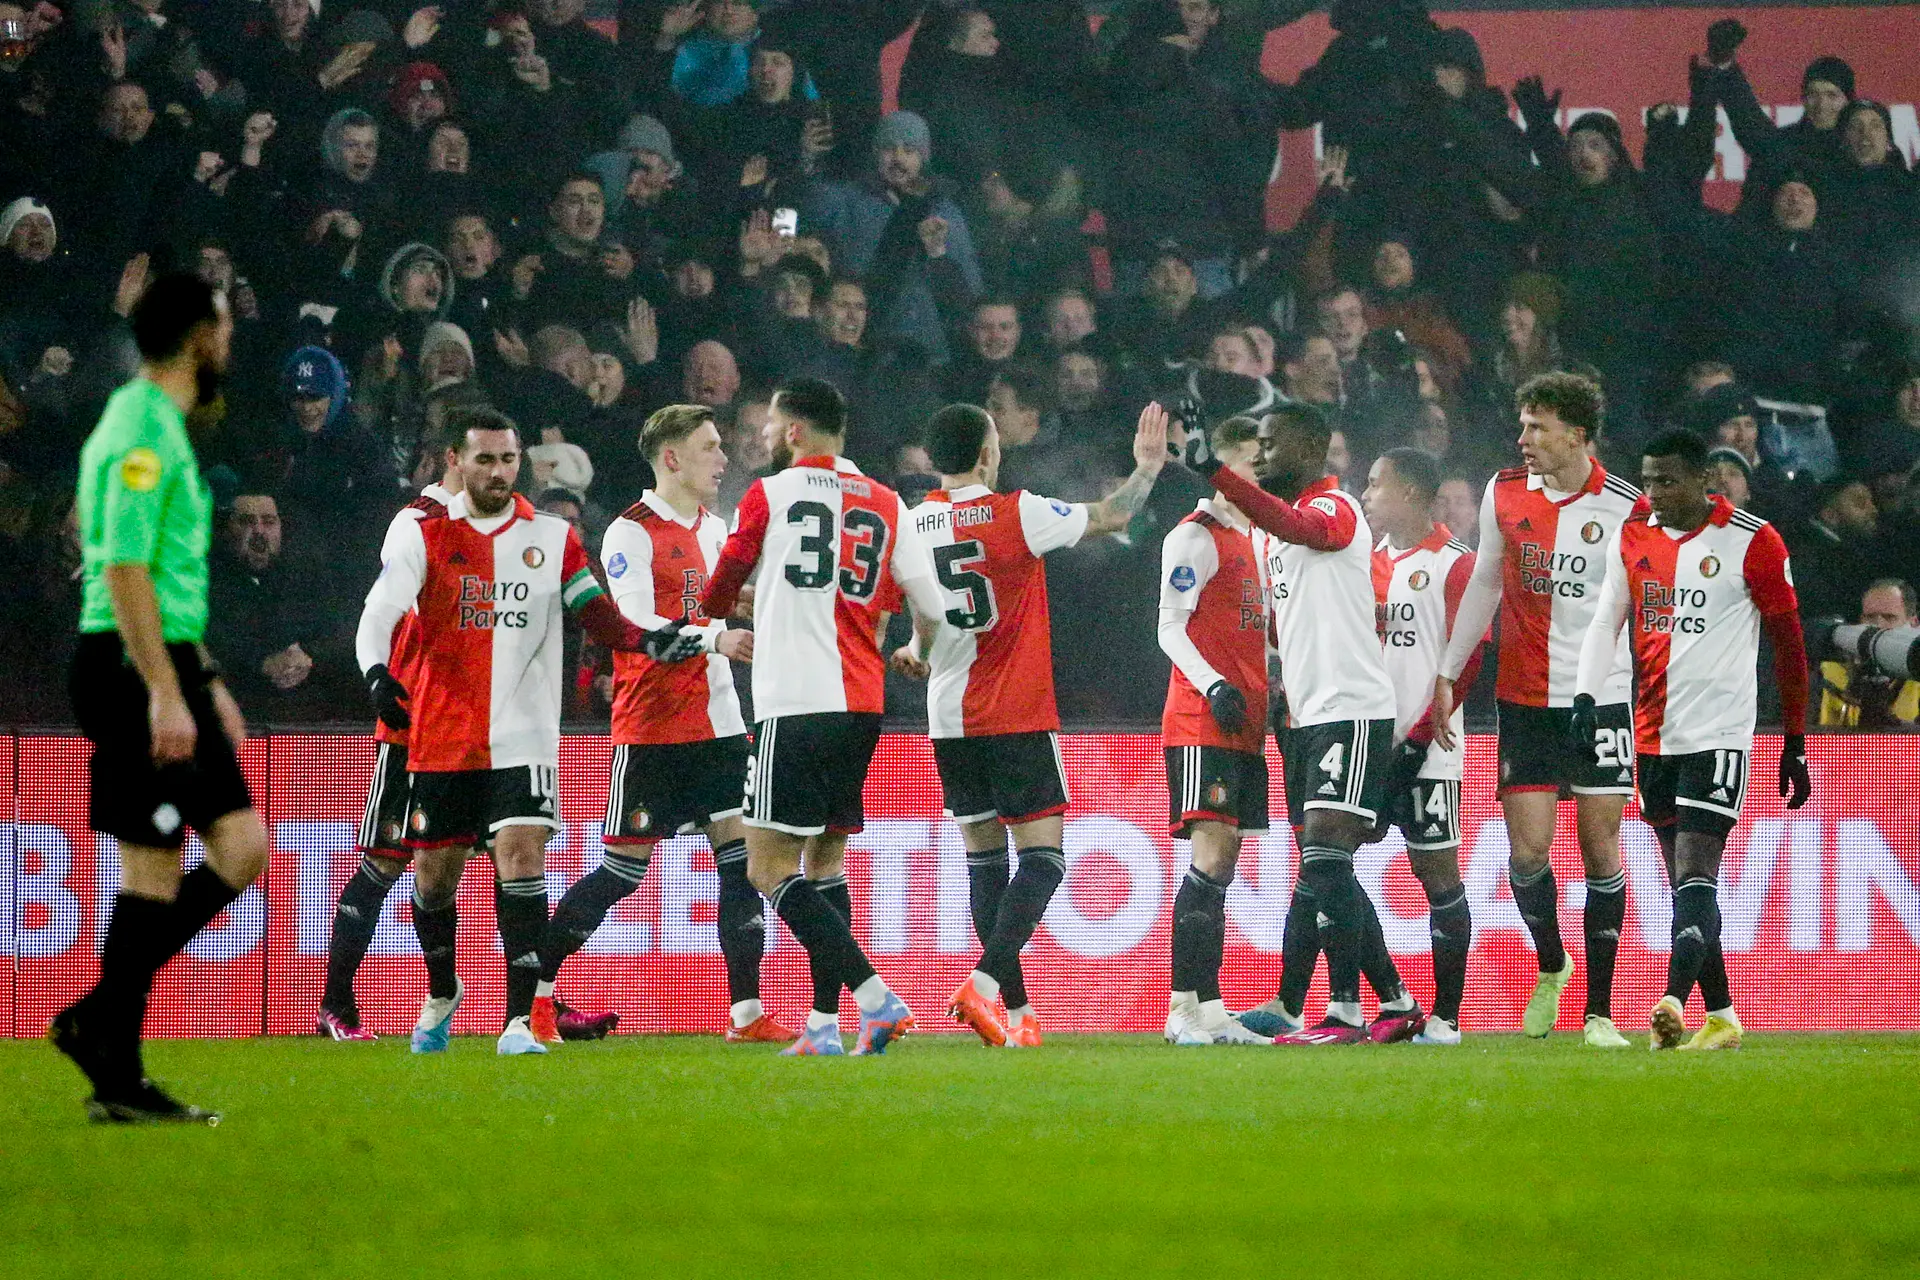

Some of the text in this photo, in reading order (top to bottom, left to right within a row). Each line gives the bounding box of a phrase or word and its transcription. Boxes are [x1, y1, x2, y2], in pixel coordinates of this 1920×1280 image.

[916, 505, 993, 533] HARTMAN
[785, 500, 891, 605] 33
[1519, 543, 1587, 574] Euro
[460, 575, 529, 601] Euro
[933, 539, 999, 632] 5
[1520, 571, 1585, 598] Parcs
[1642, 582, 1706, 609] Euro
[459, 603, 529, 629] Parcs
[1375, 602, 1415, 622] uro
[1642, 609, 1706, 634] Parcs
[1318, 742, 1344, 781] 4
[1595, 728, 1633, 767] 20
[1712, 750, 1738, 789] 11
[1411, 782, 1447, 822] 14
